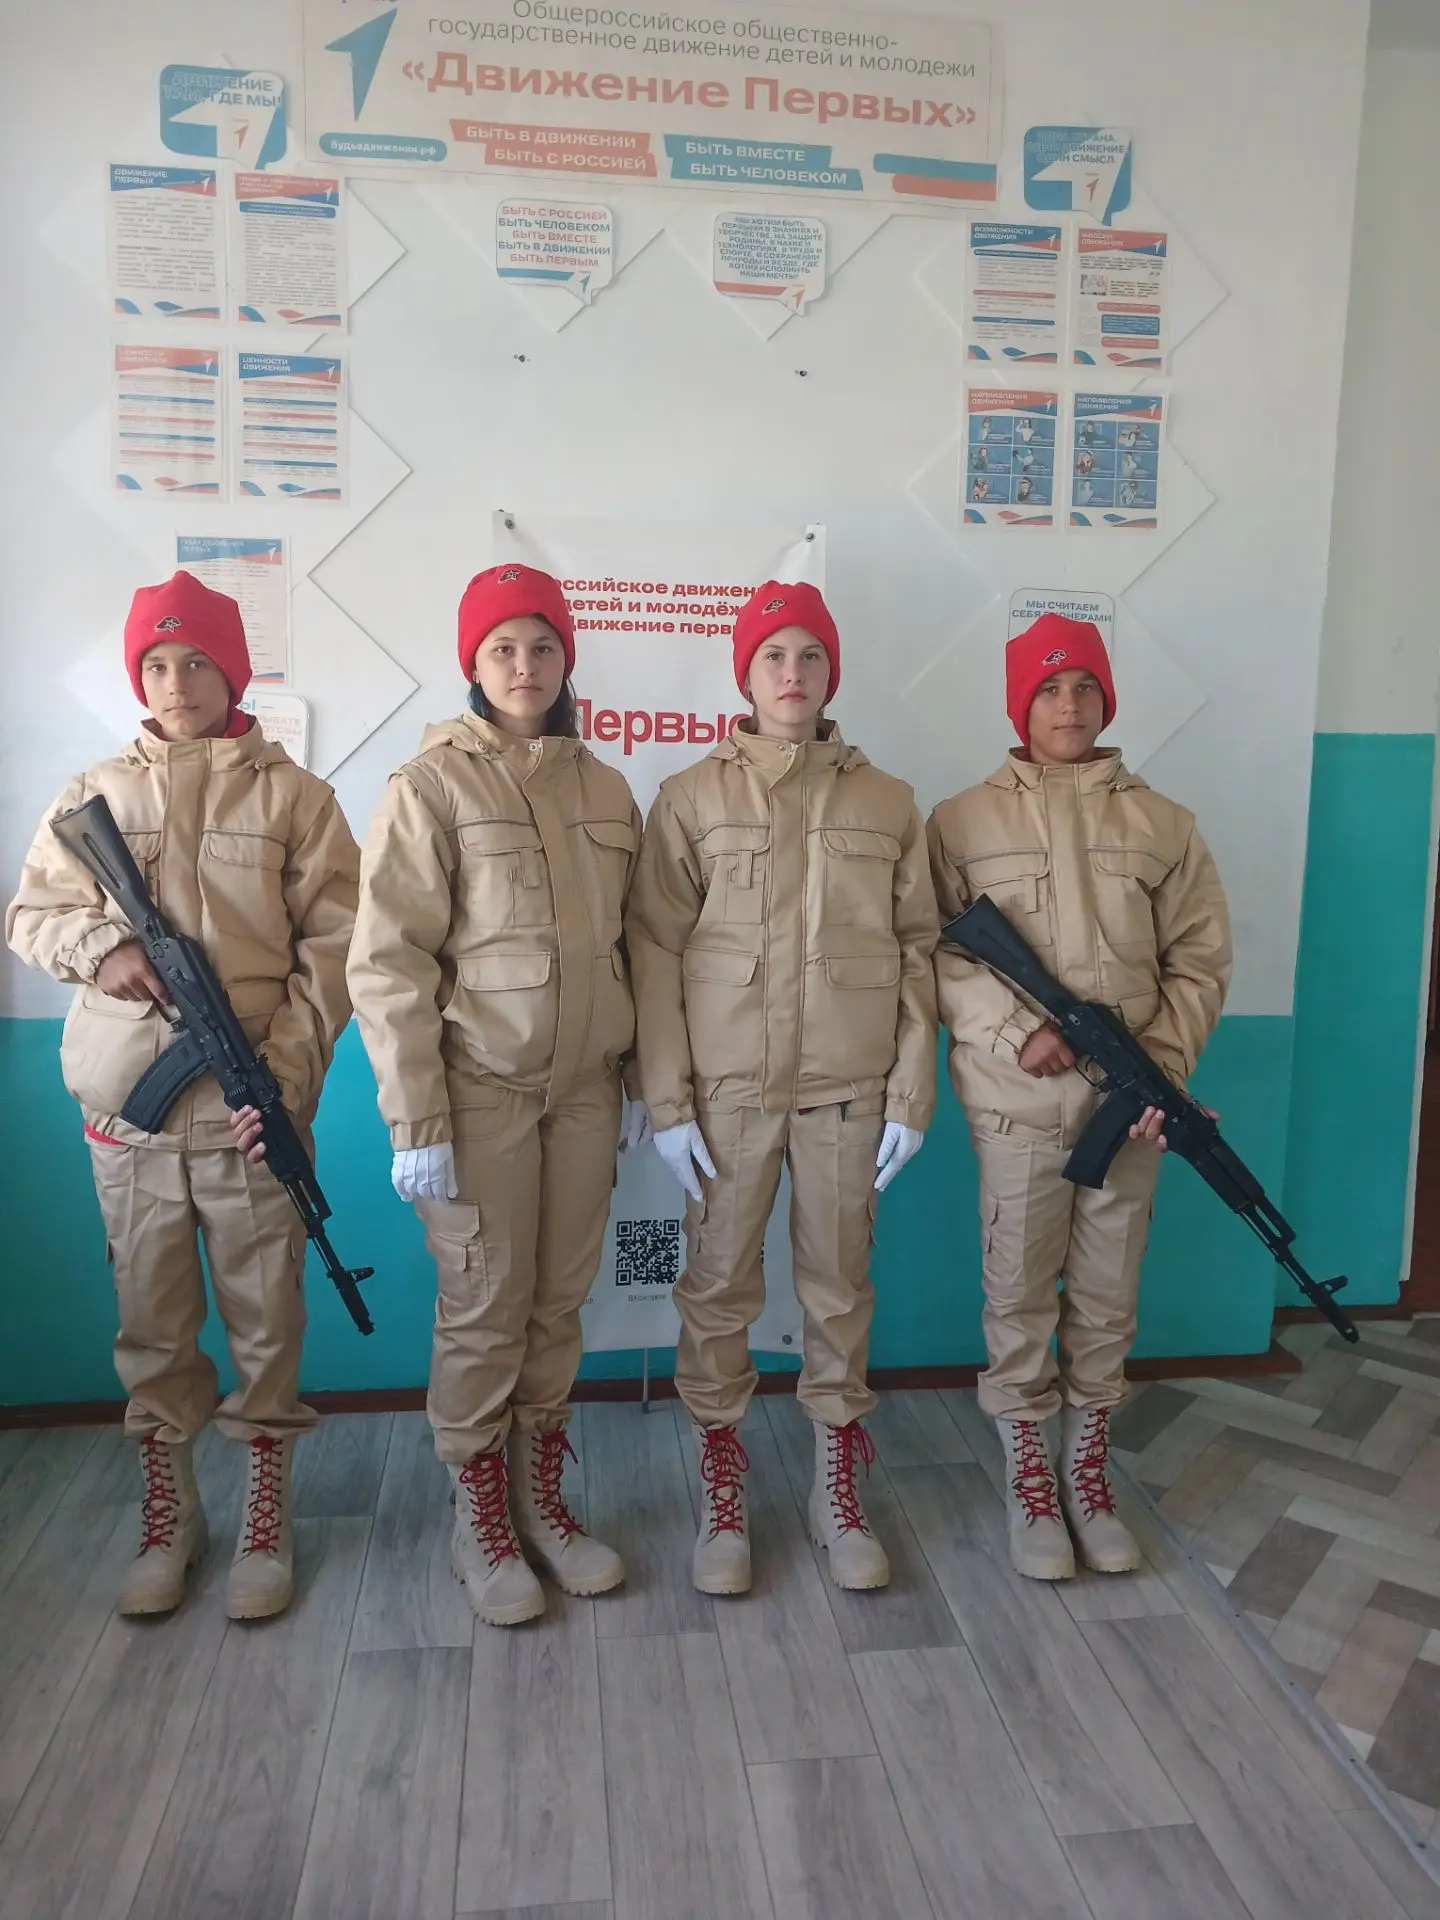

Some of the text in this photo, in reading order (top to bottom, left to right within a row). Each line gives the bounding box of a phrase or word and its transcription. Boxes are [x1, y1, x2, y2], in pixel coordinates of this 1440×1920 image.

[513, 0, 898, 50] Общероссийское общественно-
[428, 16, 976, 77] государственное движение детей и молодежи
[402, 51, 976, 127] «Движение Первых»
[466, 125, 636, 149] БЫТЬ В ДВИЖЕНИИ
[686, 141, 806, 162] БЫТЬ ВМЕСТЕ
[1062, 143, 1125, 153] ВИЖЕНИЕ
[494, 149, 647, 170] БЫТЬ С РОССИЕЙ
[1072, 154, 1115, 164] СМЫСЛ
[690, 162, 847, 185] БЫТЬ ЧЕЛОВЕКОМ
[502, 206, 607, 220] БЫТЬ С РОССИЕЙ
[498, 217, 610, 232] БЫТЬ ЧЕЛОВЕКОМ
[512, 230, 597, 244] БЫТЬ ВМЕСТЕ
[498, 241, 611, 255] БЫТЬ В ДВИЖЕНИИ
[510, 253, 599, 267] БЫТЬ ПЕРВЫМ
[673, 584, 758, 598] движен
[628, 602, 641, 612] и
[646, 601, 744, 617] молодёж
[1026, 600, 1099, 612] МЫ СЧИТАЕМ
[1012, 609, 1112, 622] СЕБЯ ОНЕРАМИ
[571, 615, 735, 637] вижение перв
